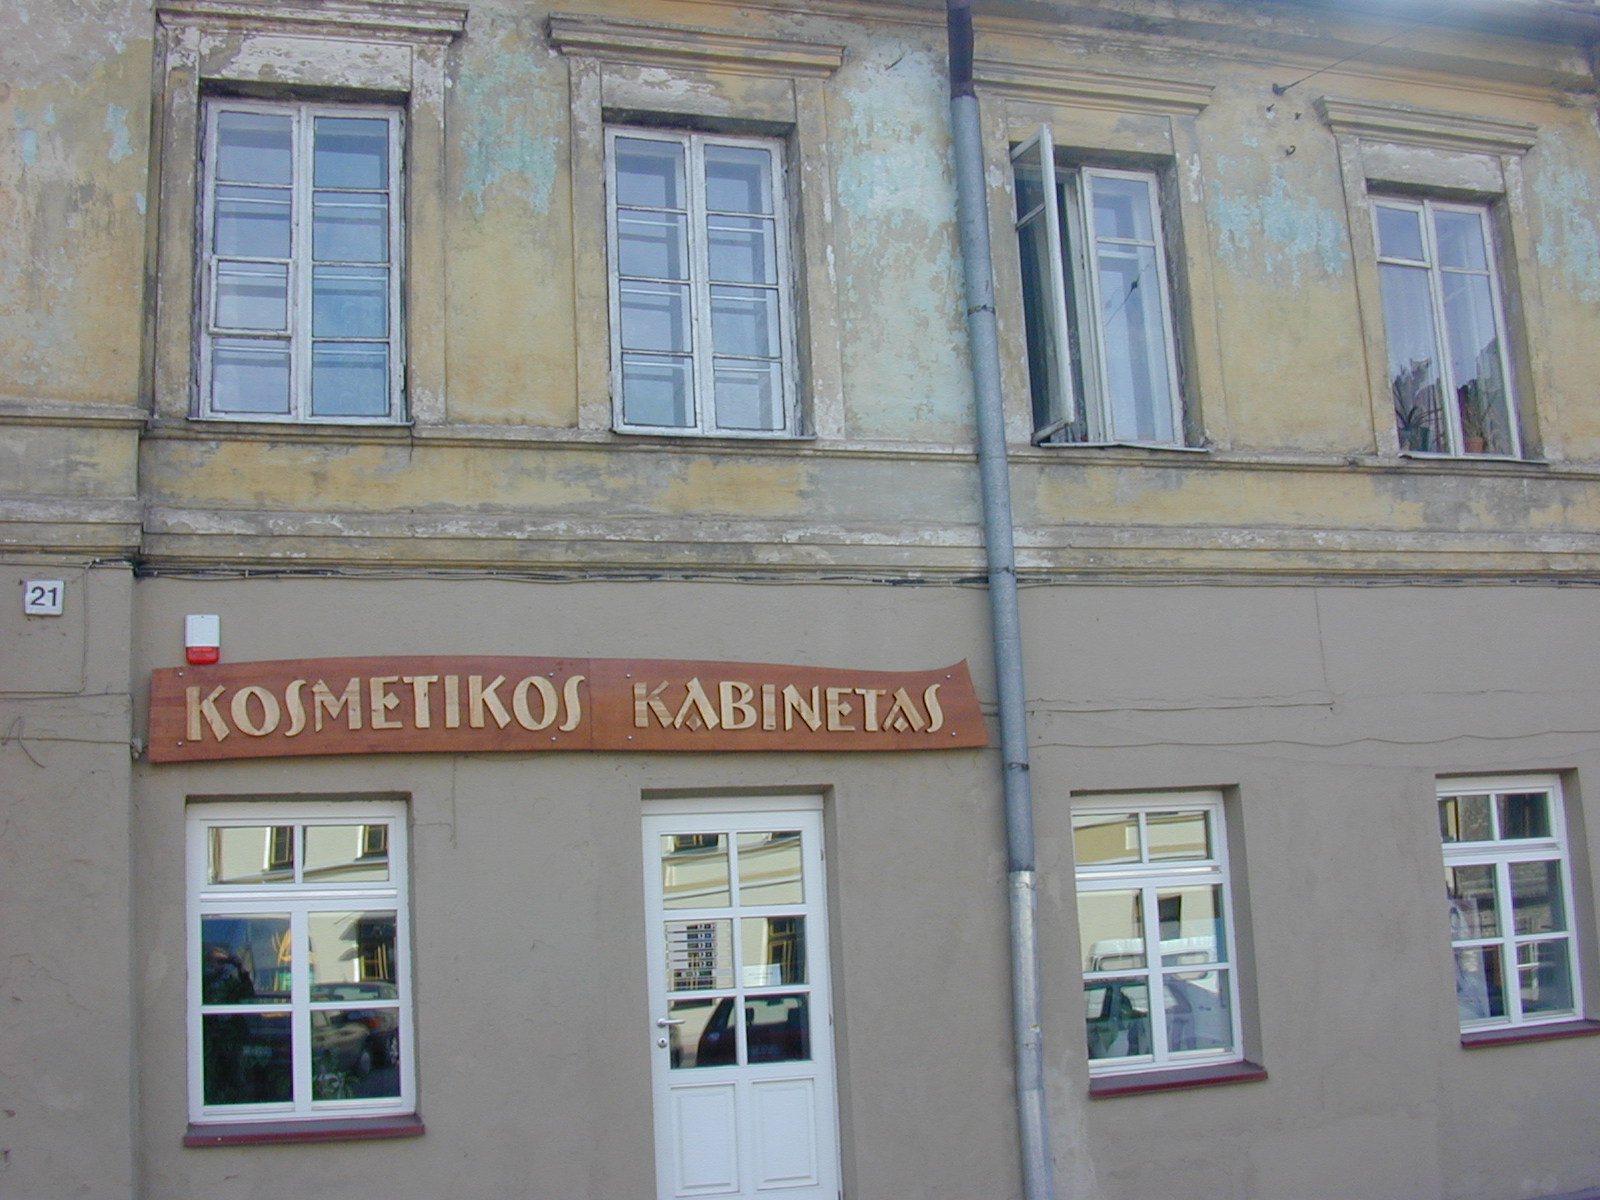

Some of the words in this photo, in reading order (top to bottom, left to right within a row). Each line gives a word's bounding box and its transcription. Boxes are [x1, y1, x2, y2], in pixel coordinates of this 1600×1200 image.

[30, 586, 58, 607] 21
[186, 675, 586, 742] KOSMETIKOS
[633, 676, 944, 733] KABINETAS
